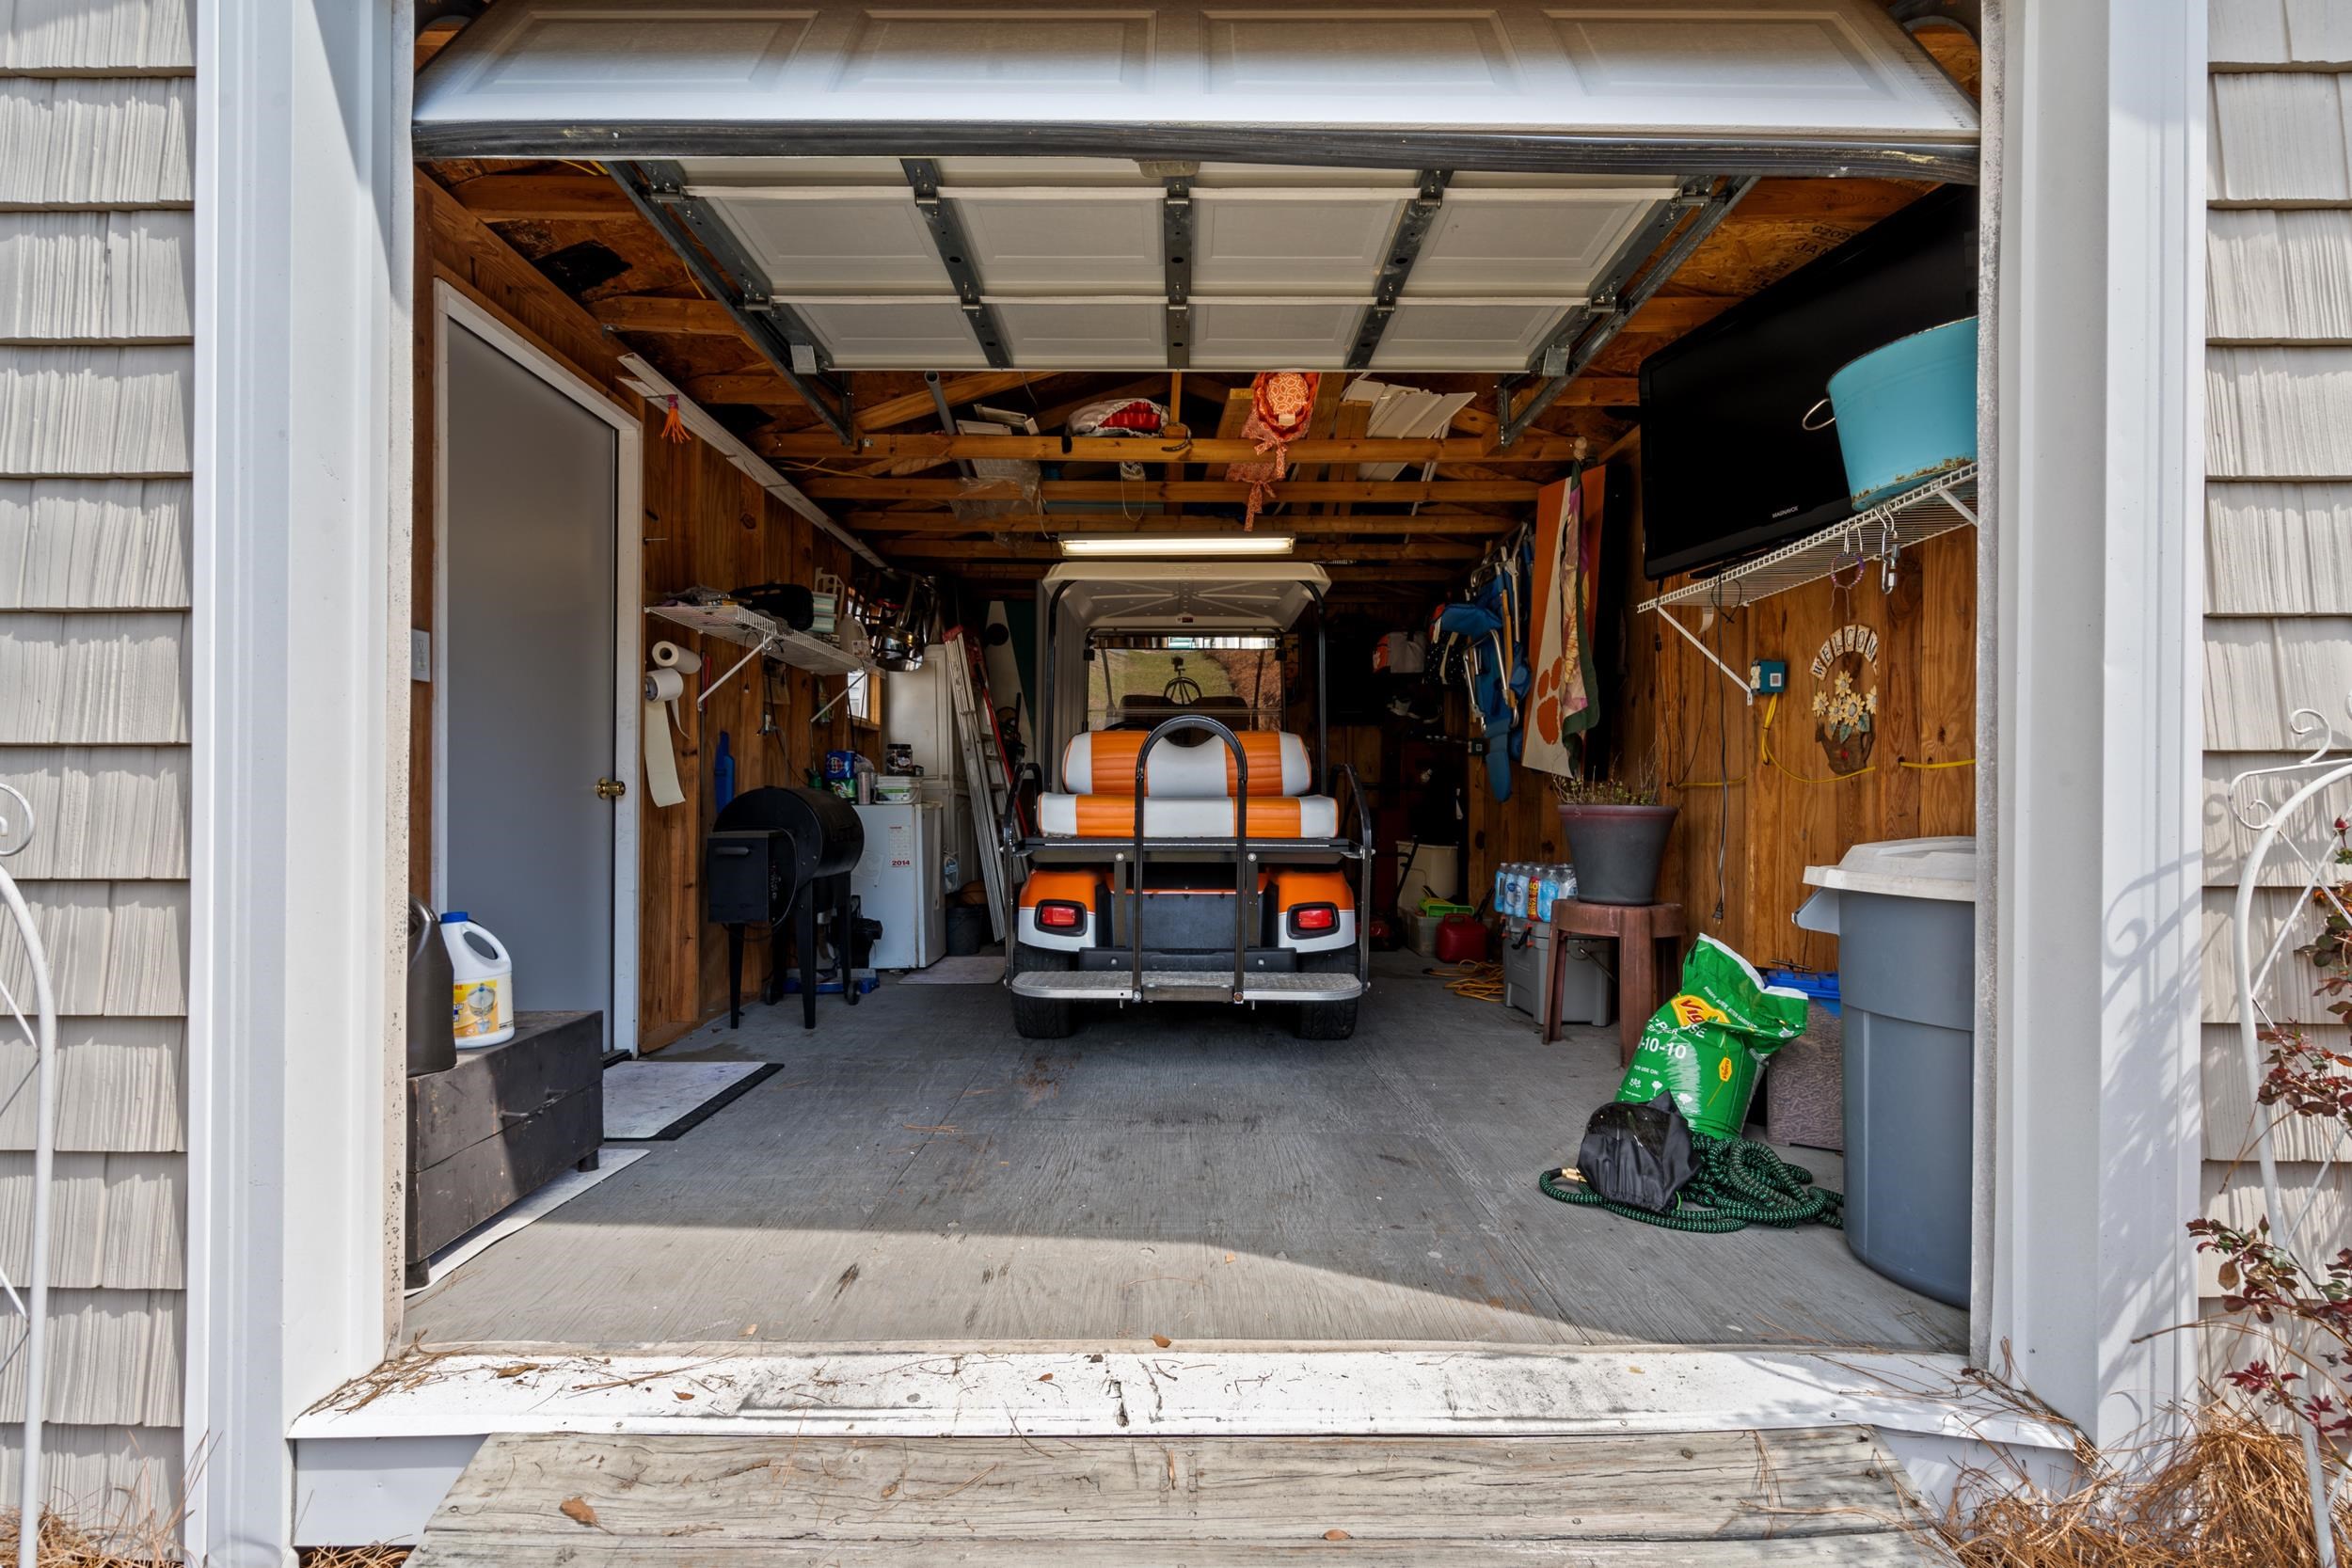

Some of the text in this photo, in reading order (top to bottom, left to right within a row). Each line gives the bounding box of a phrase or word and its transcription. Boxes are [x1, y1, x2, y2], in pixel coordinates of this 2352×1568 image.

[1772, 505, 1799, 518] MAGNAVOX
[1811, 626, 1878, 677] WELCOM
[1680, 999, 1705, 1024] Vig
